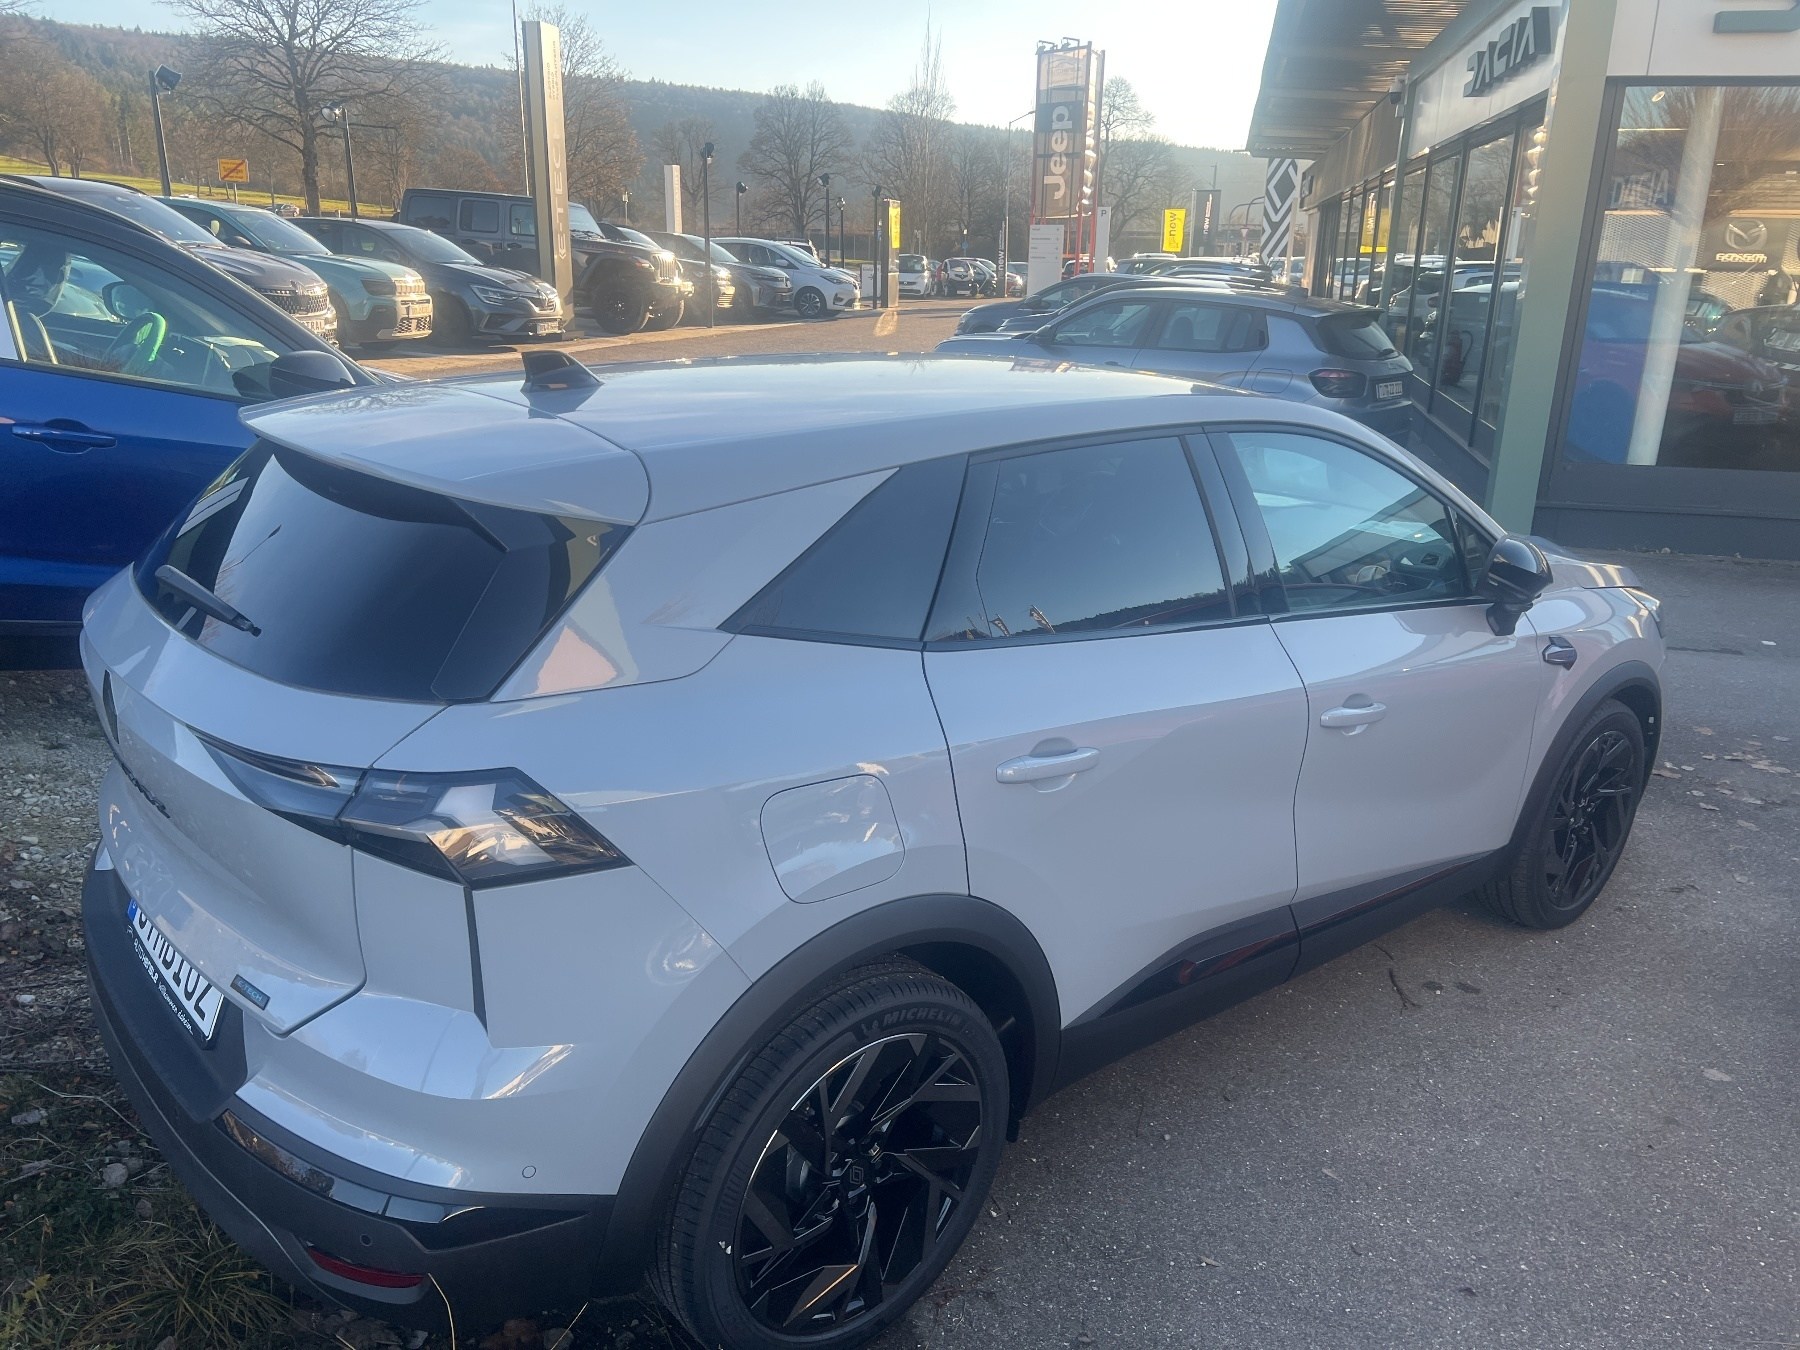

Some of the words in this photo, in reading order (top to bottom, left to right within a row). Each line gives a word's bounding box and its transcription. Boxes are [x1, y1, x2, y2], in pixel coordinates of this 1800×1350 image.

[1463, 7, 1545, 98] DACIA
[1043, 105, 1073, 200] Jeep
[883, 1007, 962, 1027] MICHELIN
